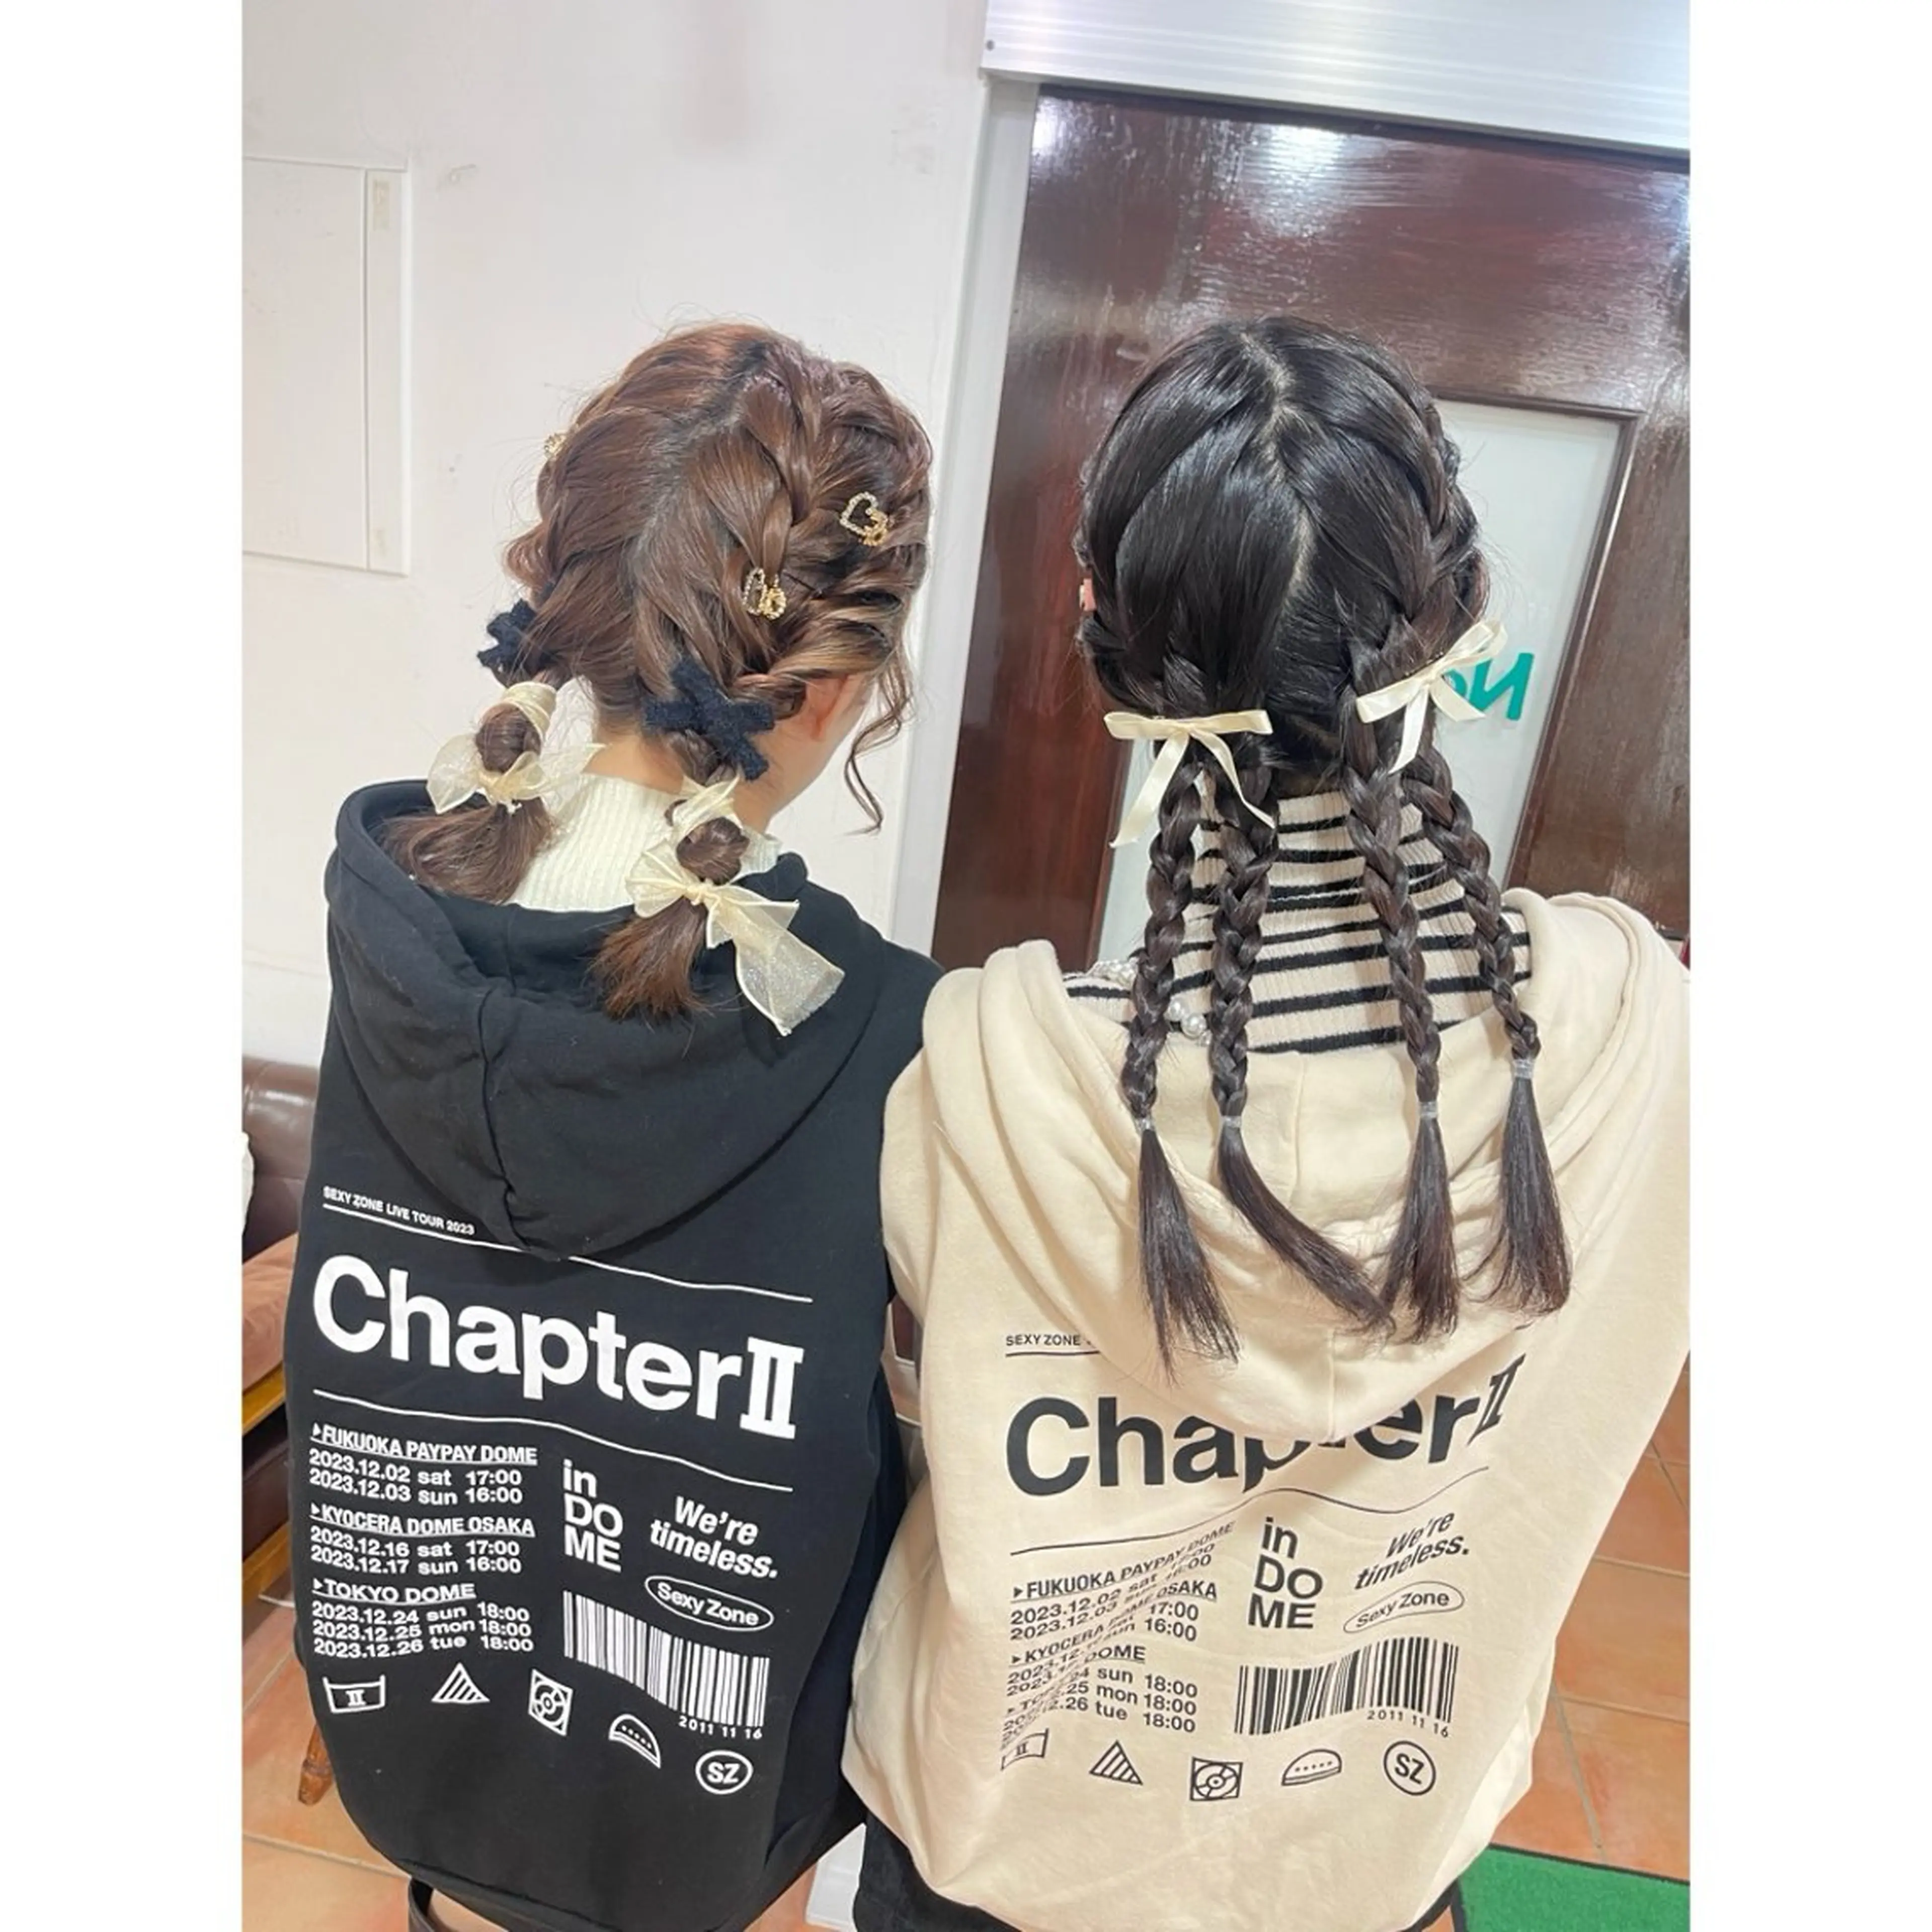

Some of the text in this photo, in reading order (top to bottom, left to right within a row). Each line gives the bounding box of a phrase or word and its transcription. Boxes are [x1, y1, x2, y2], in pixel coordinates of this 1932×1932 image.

[323, 1186, 475, 1235] SEXY ZONE LIVE TOUR 2023
[1006, 1333, 1081, 1346] SEXY ZONE
[322, 1424, 537, 1463] FUKUOKA PAYPAY DOME
[309, 1448, 522, 1486] 2023.12.02 sat 17:00
[563, 1458, 598, 1498] in
[309, 1469, 523, 1505] 2023.12.03 sun 16:00
[321, 1503, 535, 1535] KYOCERA DOME OSAKA
[564, 1492, 623, 1538] DO
[310, 1525, 520, 1558] 2023.12.16 sat 17:00
[564, 1524, 622, 1573] ME
[650, 1519, 778, 1579] timeless.
[1261, 1517, 1298, 1559] in
[310, 1545, 522, 1575] 2023.12.17 sun 16:00
[1253, 1554, 1323, 1599] DO
[1354, 1536, 1469, 1590] timeless.
[324, 1578, 477, 1603] TOKYO DOME
[1027, 1570, 1115, 1598] FUKUOKA
[1157, 1580, 1218, 1599] OSAKA
[312, 1601, 530, 1625] 2023.12.24 sun 18:00
[658, 1582, 759, 1626] Sexy Zone
[1010, 1588, 1121, 1625] 2023.12.02
[1150, 1601, 1199, 1621] 17:00
[1247, 1593, 1316, 1629] ME
[1356, 1592, 1450, 1628] Sexy Zone
[312, 1619, 531, 1642] 2023.12.25 mon 18:00
[1010, 1601, 1117, 1641] 2023.12.03
[1145, 1618, 1197, 1642] 16:00
[313, 1635, 534, 1659] 2023.12.26 tue 18:00
[1097, 1667, 1133, 1684] sun
[1145, 1673, 1198, 1698] 18:00
[1096, 1684, 1197, 1716] mon 18:00
[679, 1715, 763, 1740] 2011 11 16
[1095, 1701, 1196, 1733] tue 18:00
[1367, 1710, 1448, 1738] 2011 11 16
[707, 1761, 740, 1784] SZ
[1395, 1752, 1424, 1785] SZ
